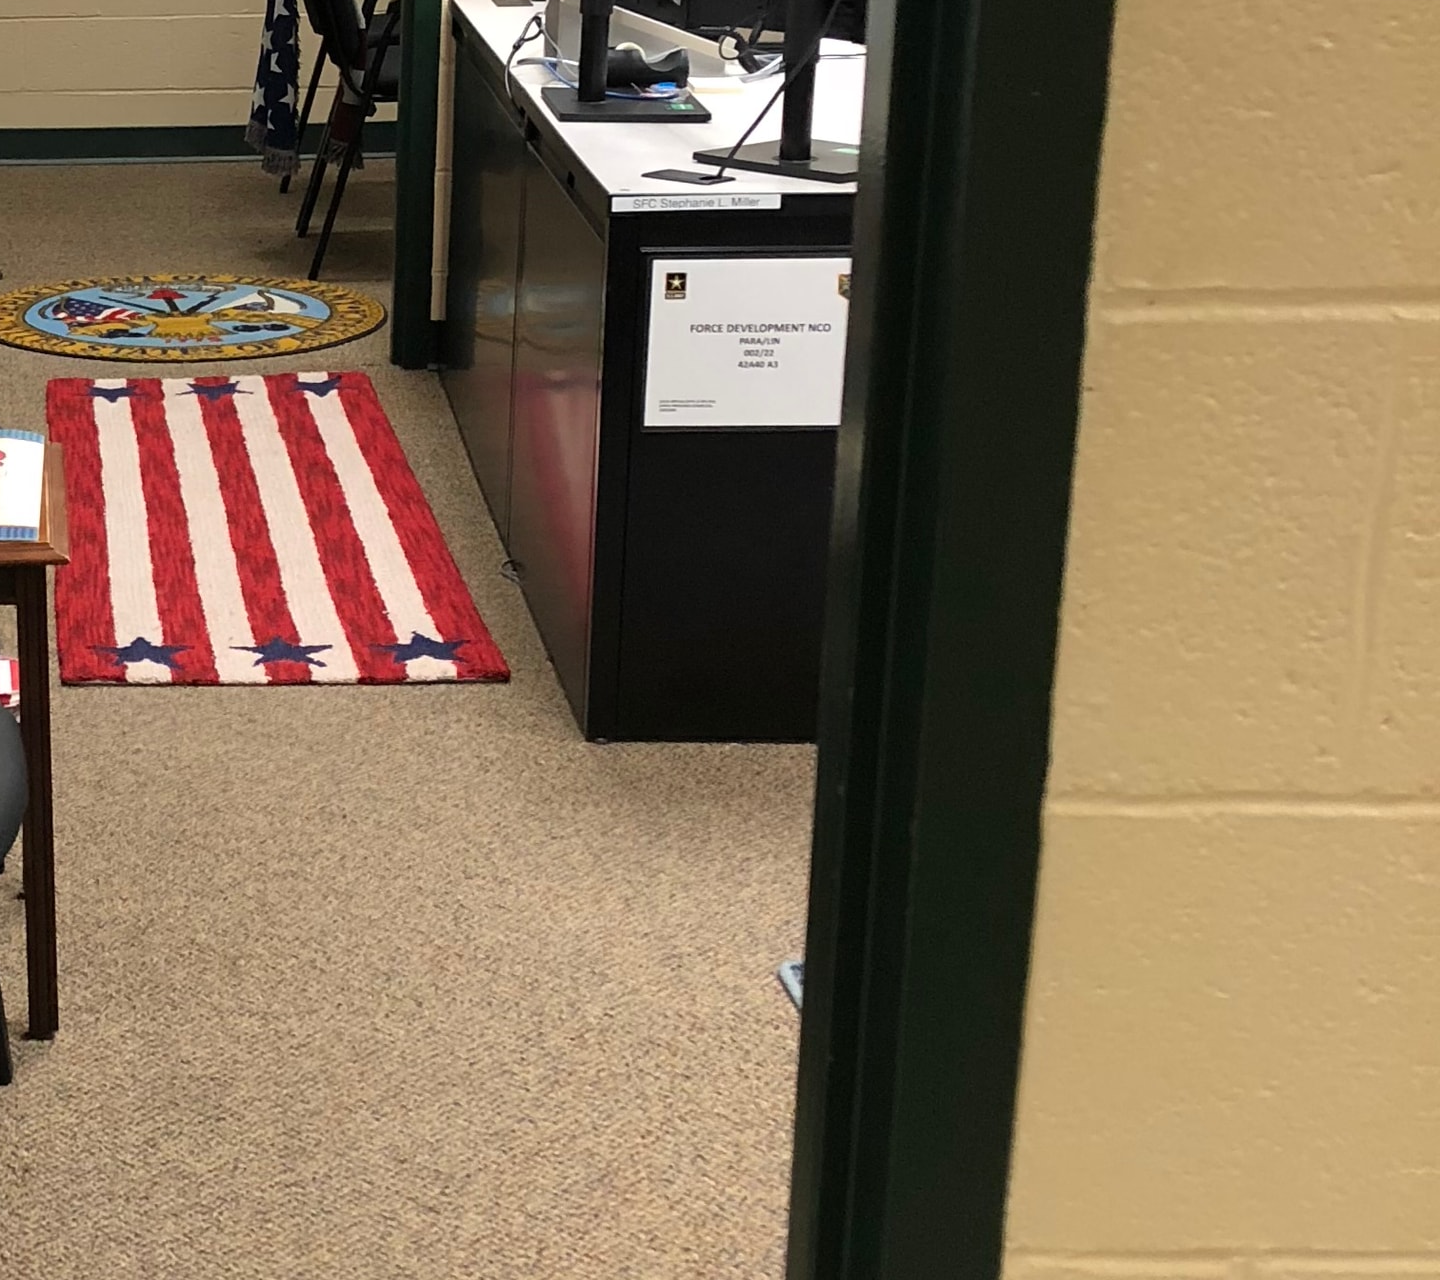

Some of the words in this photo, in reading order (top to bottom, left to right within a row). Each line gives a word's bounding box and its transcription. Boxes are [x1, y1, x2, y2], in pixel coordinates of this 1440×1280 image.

[632, 198, 658, 209] SFC
[660, 197, 716, 210] Stephanie
[731, 196, 761, 207] Miller
[690, 323, 724, 333] FORCE
[726, 323, 806, 333] DEVELOPMENT
[808, 323, 832, 333] NCO
